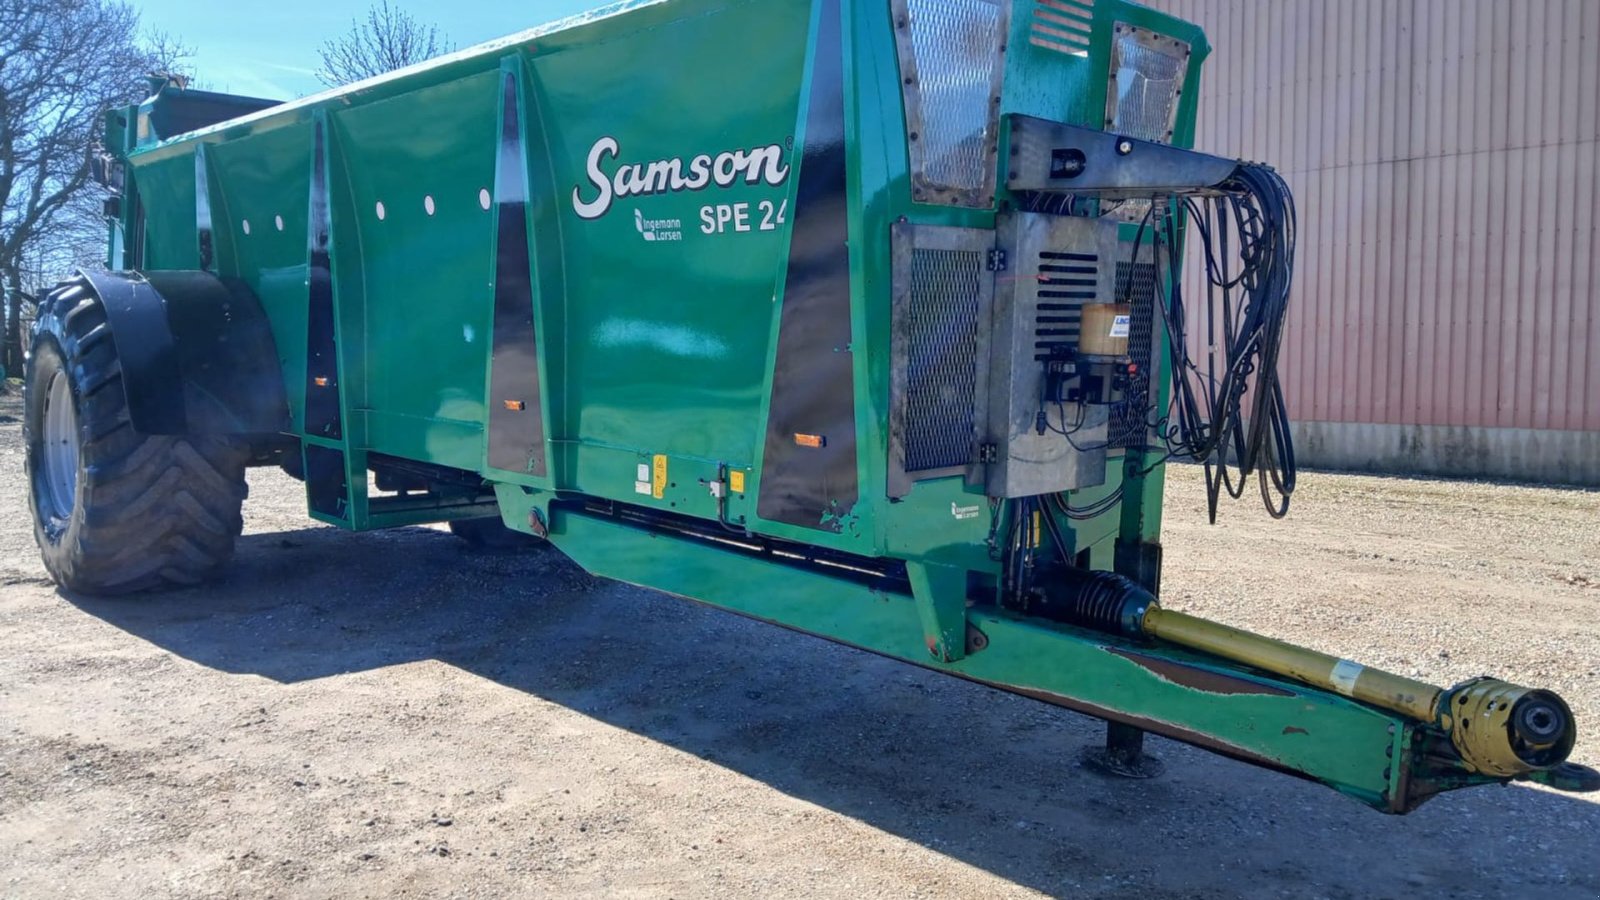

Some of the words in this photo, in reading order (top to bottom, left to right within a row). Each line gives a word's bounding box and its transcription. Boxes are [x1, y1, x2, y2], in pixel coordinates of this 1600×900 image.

[572, 136, 789, 219] Samson
[643, 218, 681, 231] Ingemann
[700, 203, 750, 233] SPE
[656, 230, 682, 241] Larsen
